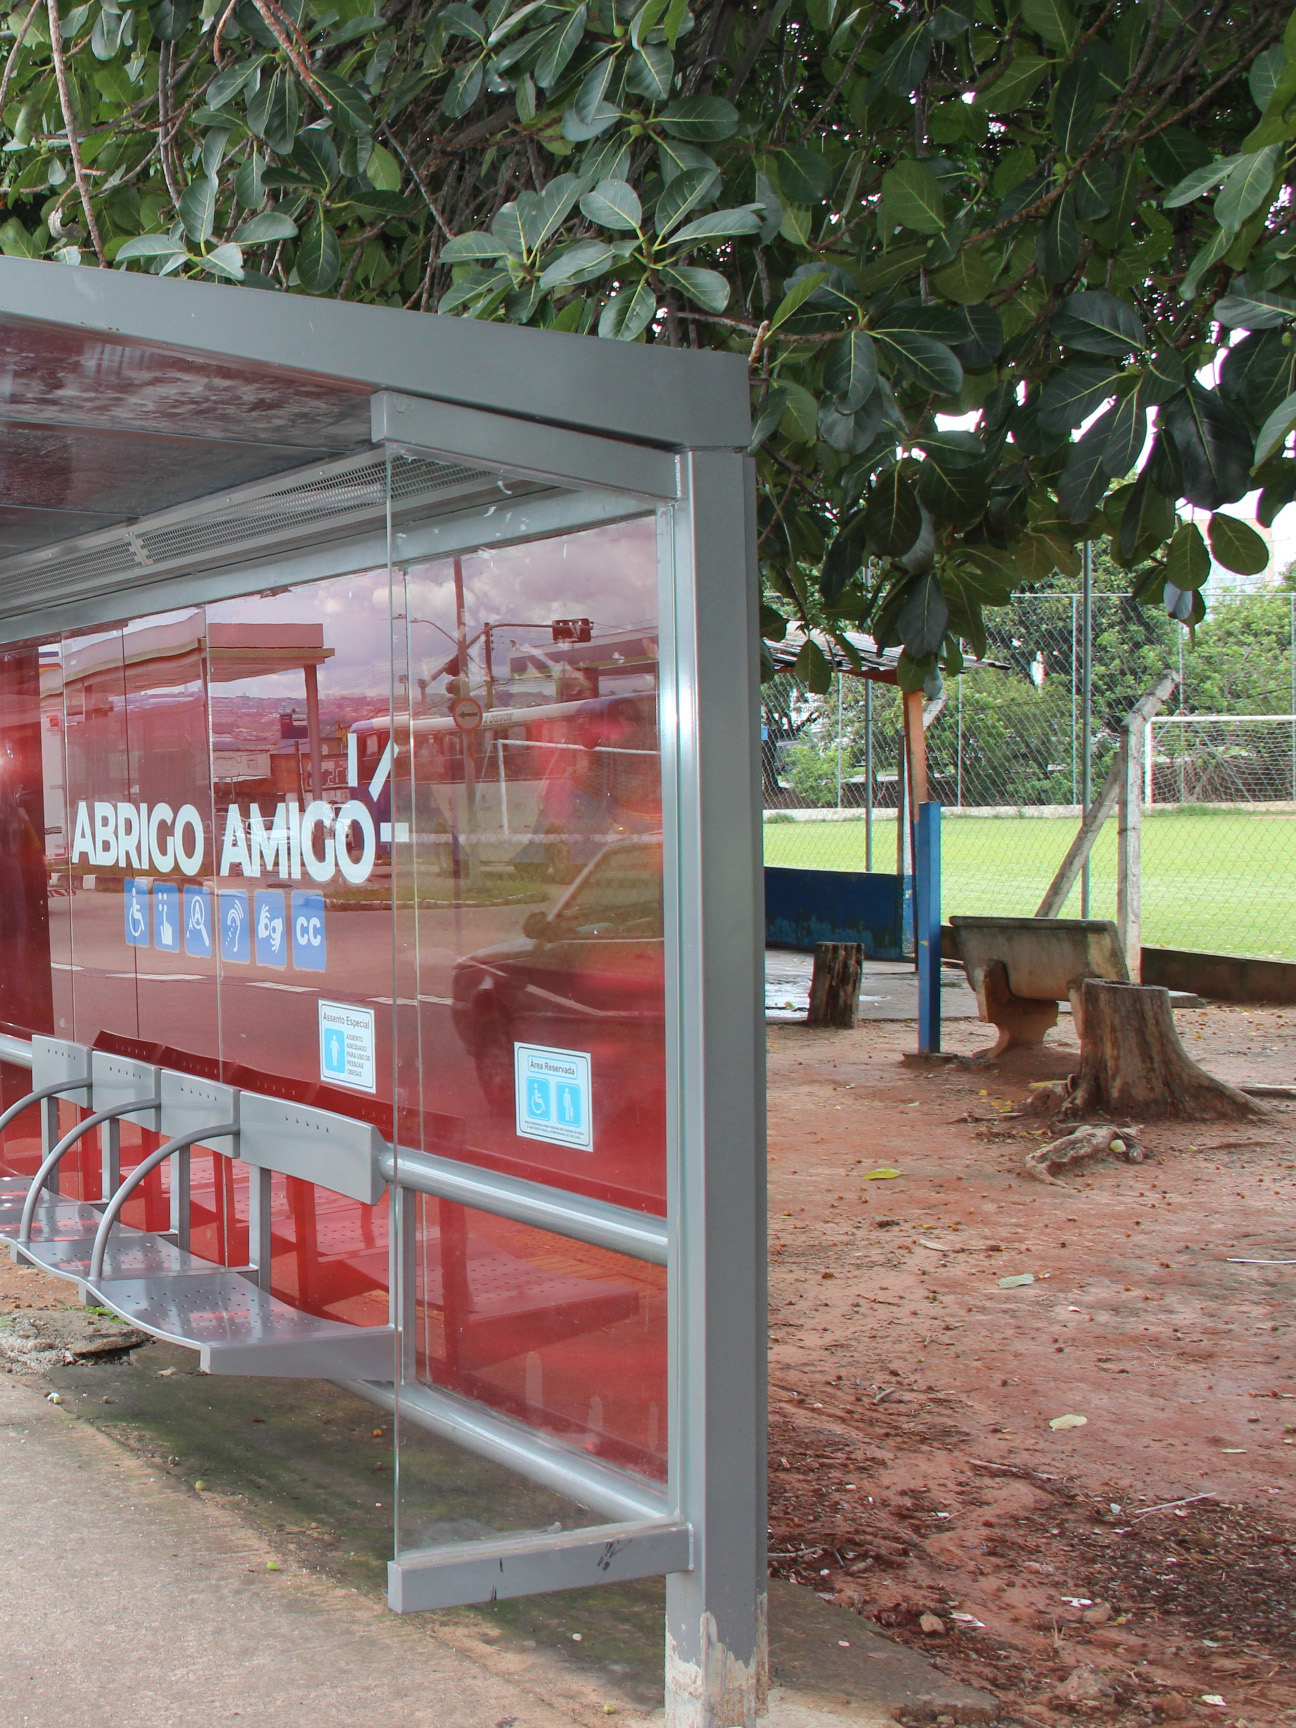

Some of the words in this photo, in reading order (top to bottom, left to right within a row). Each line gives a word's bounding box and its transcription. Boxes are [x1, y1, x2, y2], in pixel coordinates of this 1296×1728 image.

[71, 801, 205, 877] ABRIGO
[219, 799, 376, 885] AMIGO
[322, 1012, 345, 1026] Assento
[345, 1015, 370, 1031] Especial
[529, 1058, 543, 1071] Área
[544, 1061, 575, 1076] Reservada
